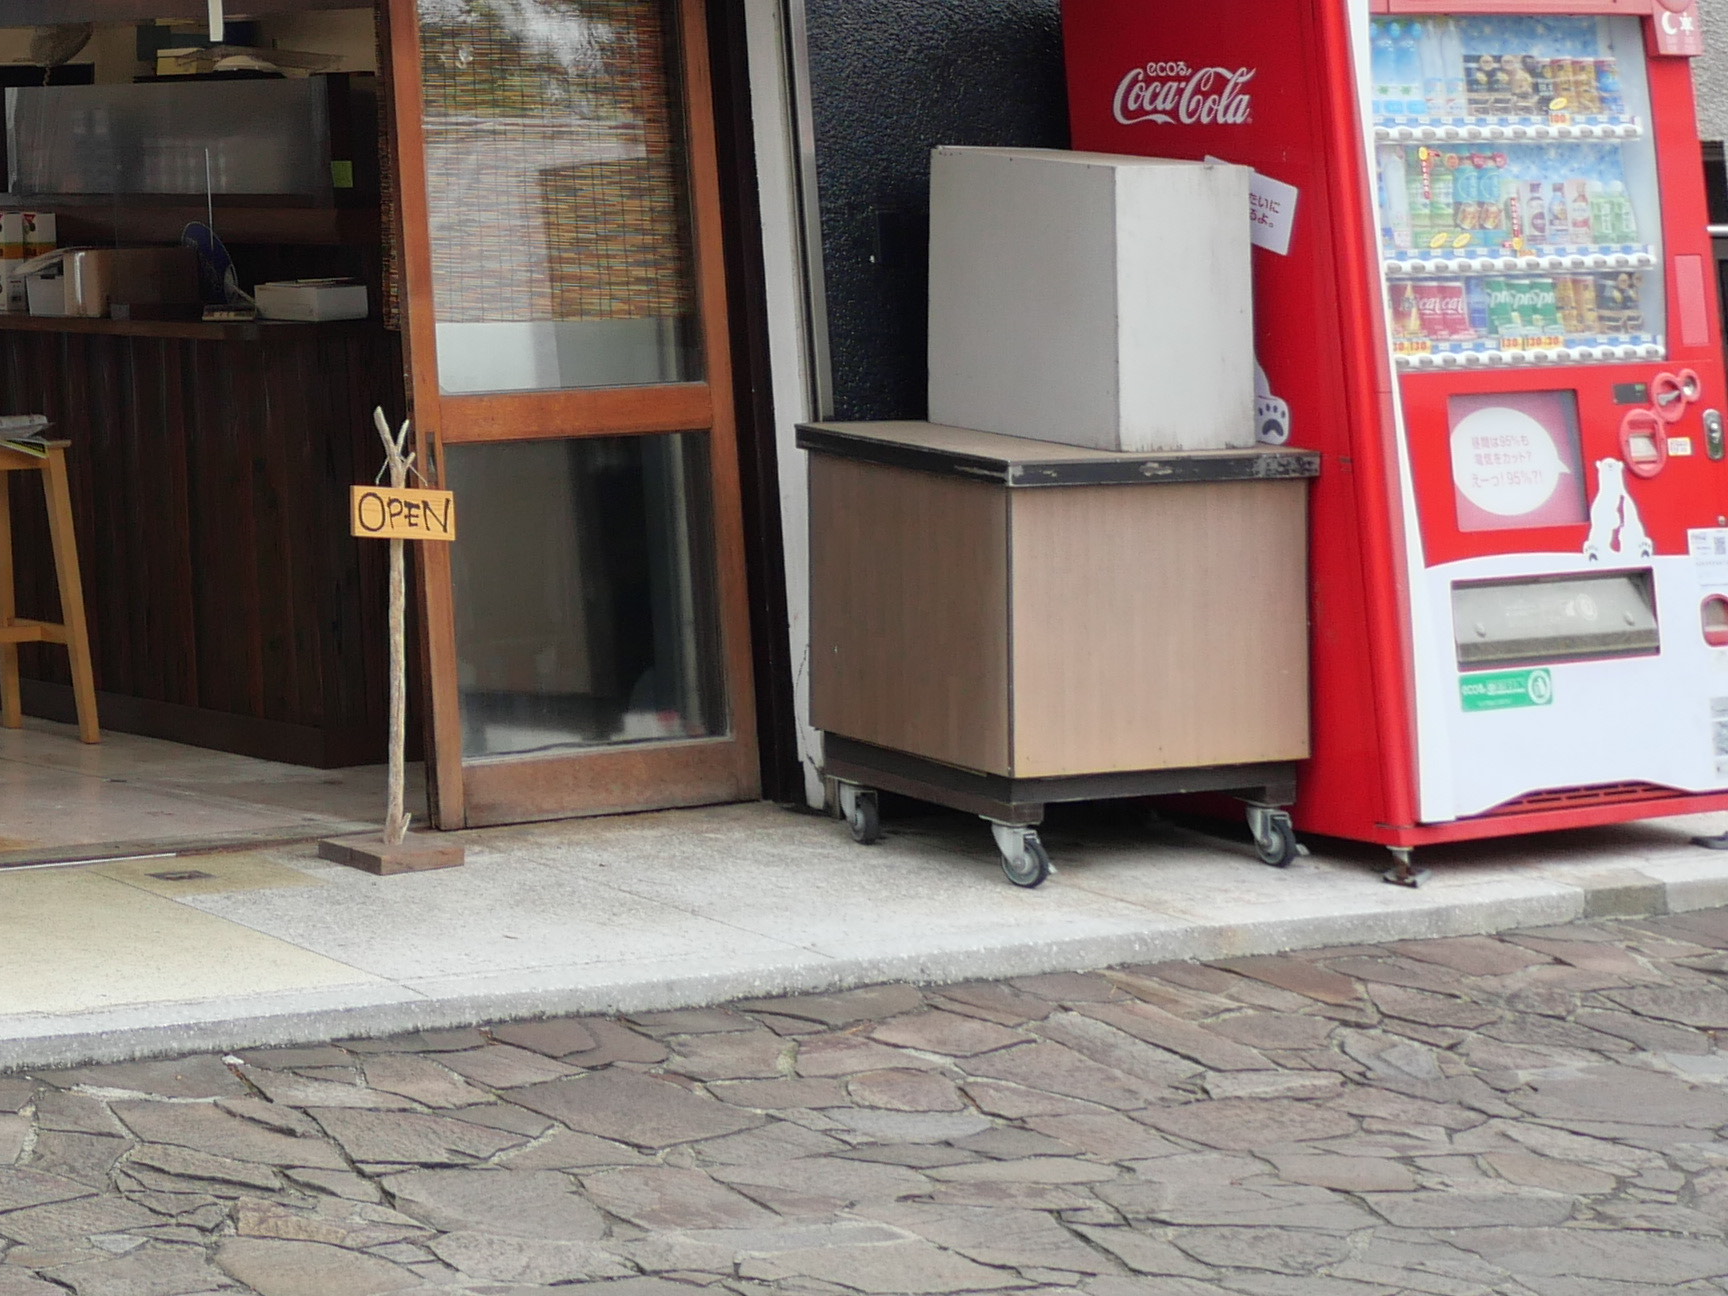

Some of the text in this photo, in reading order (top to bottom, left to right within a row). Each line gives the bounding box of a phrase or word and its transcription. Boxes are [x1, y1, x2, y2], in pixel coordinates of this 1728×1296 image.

[1112, 66, 1256, 125] Coca-Cola
[1501, 337, 1519, 348] 130
[358, 491, 451, 534] OPEN
